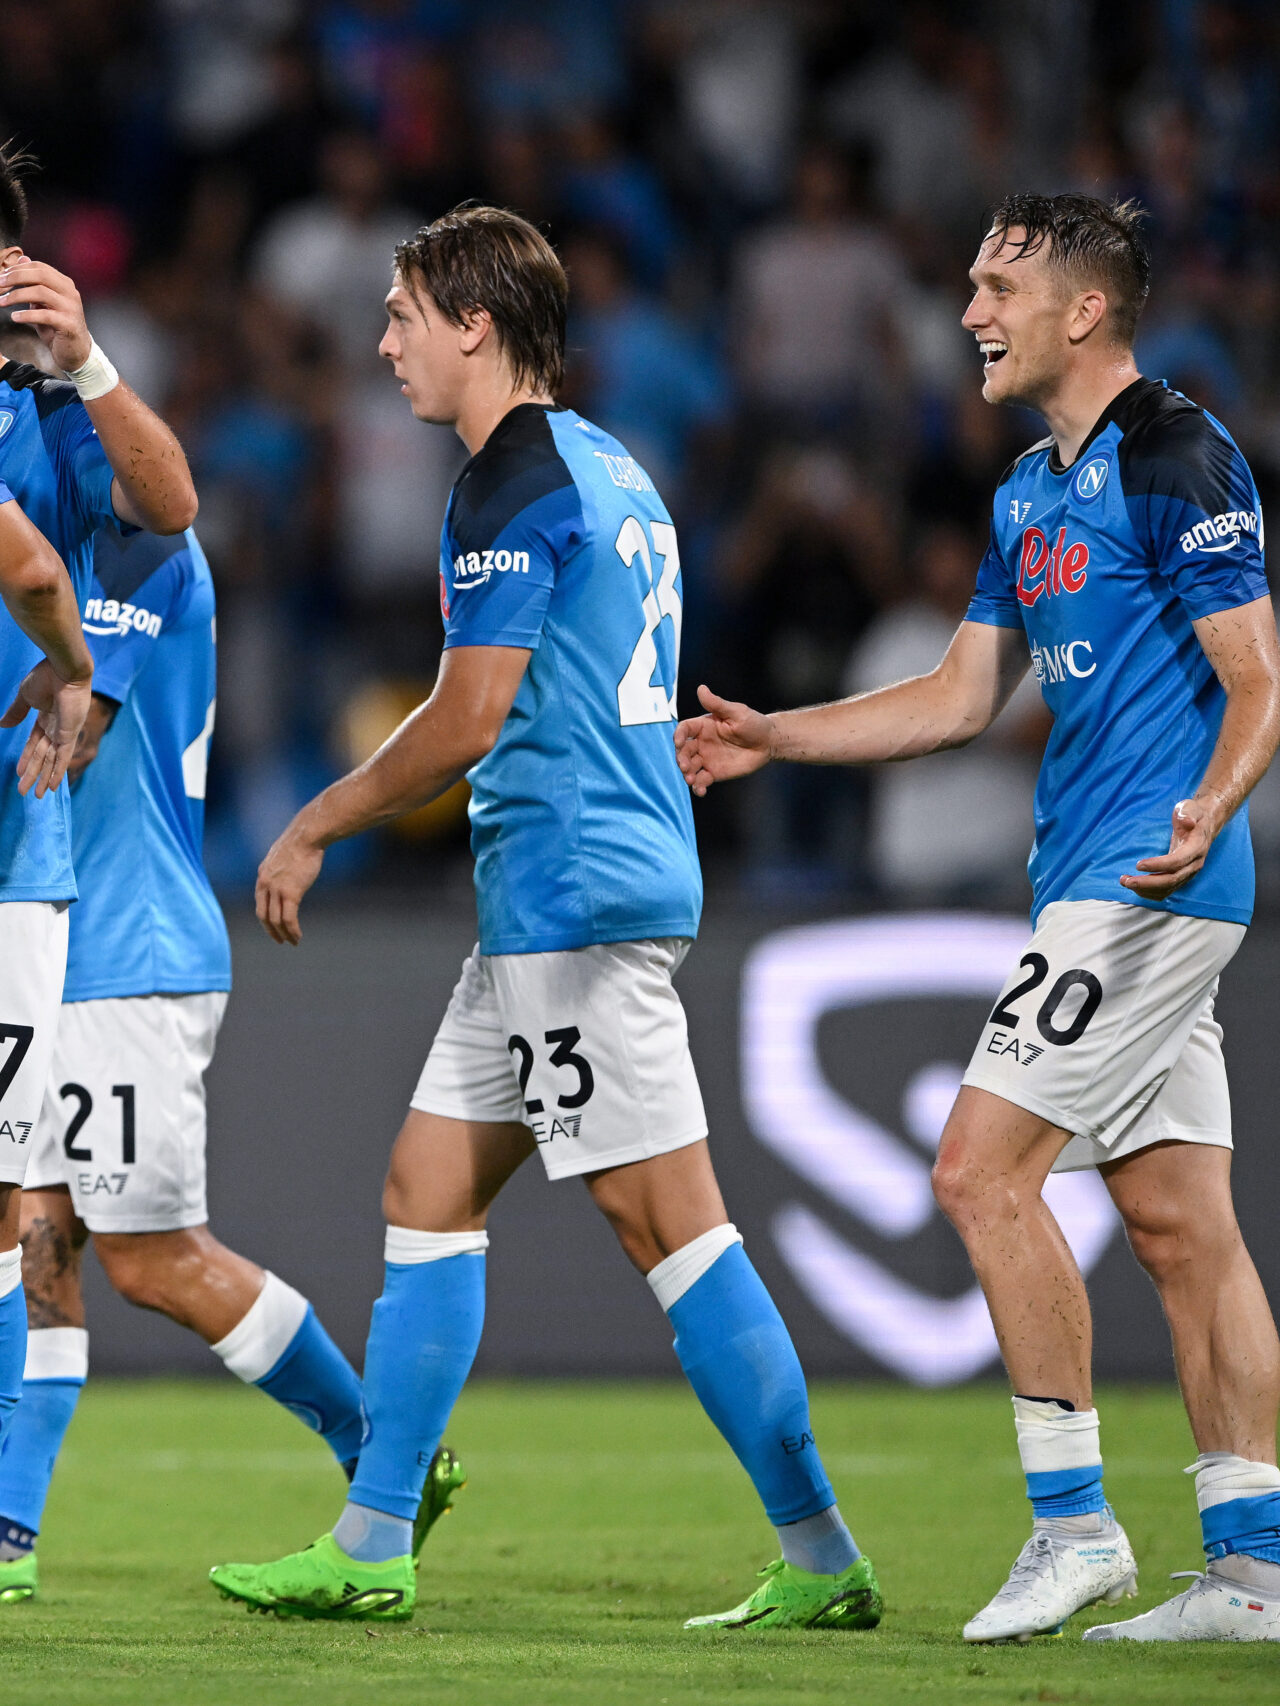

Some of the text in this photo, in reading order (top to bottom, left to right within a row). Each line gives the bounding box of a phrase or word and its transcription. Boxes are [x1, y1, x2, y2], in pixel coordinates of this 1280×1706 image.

[1179, 510, 1258, 554] amazon
[614, 514, 682, 727] 23
[988, 952, 1104, 1046] 20
[508, 1025, 594, 1115] 23
[986, 1031, 1045, 1067] EA7
[59, 1082, 136, 1165] 21
[77, 1172, 129, 1196] EA7
